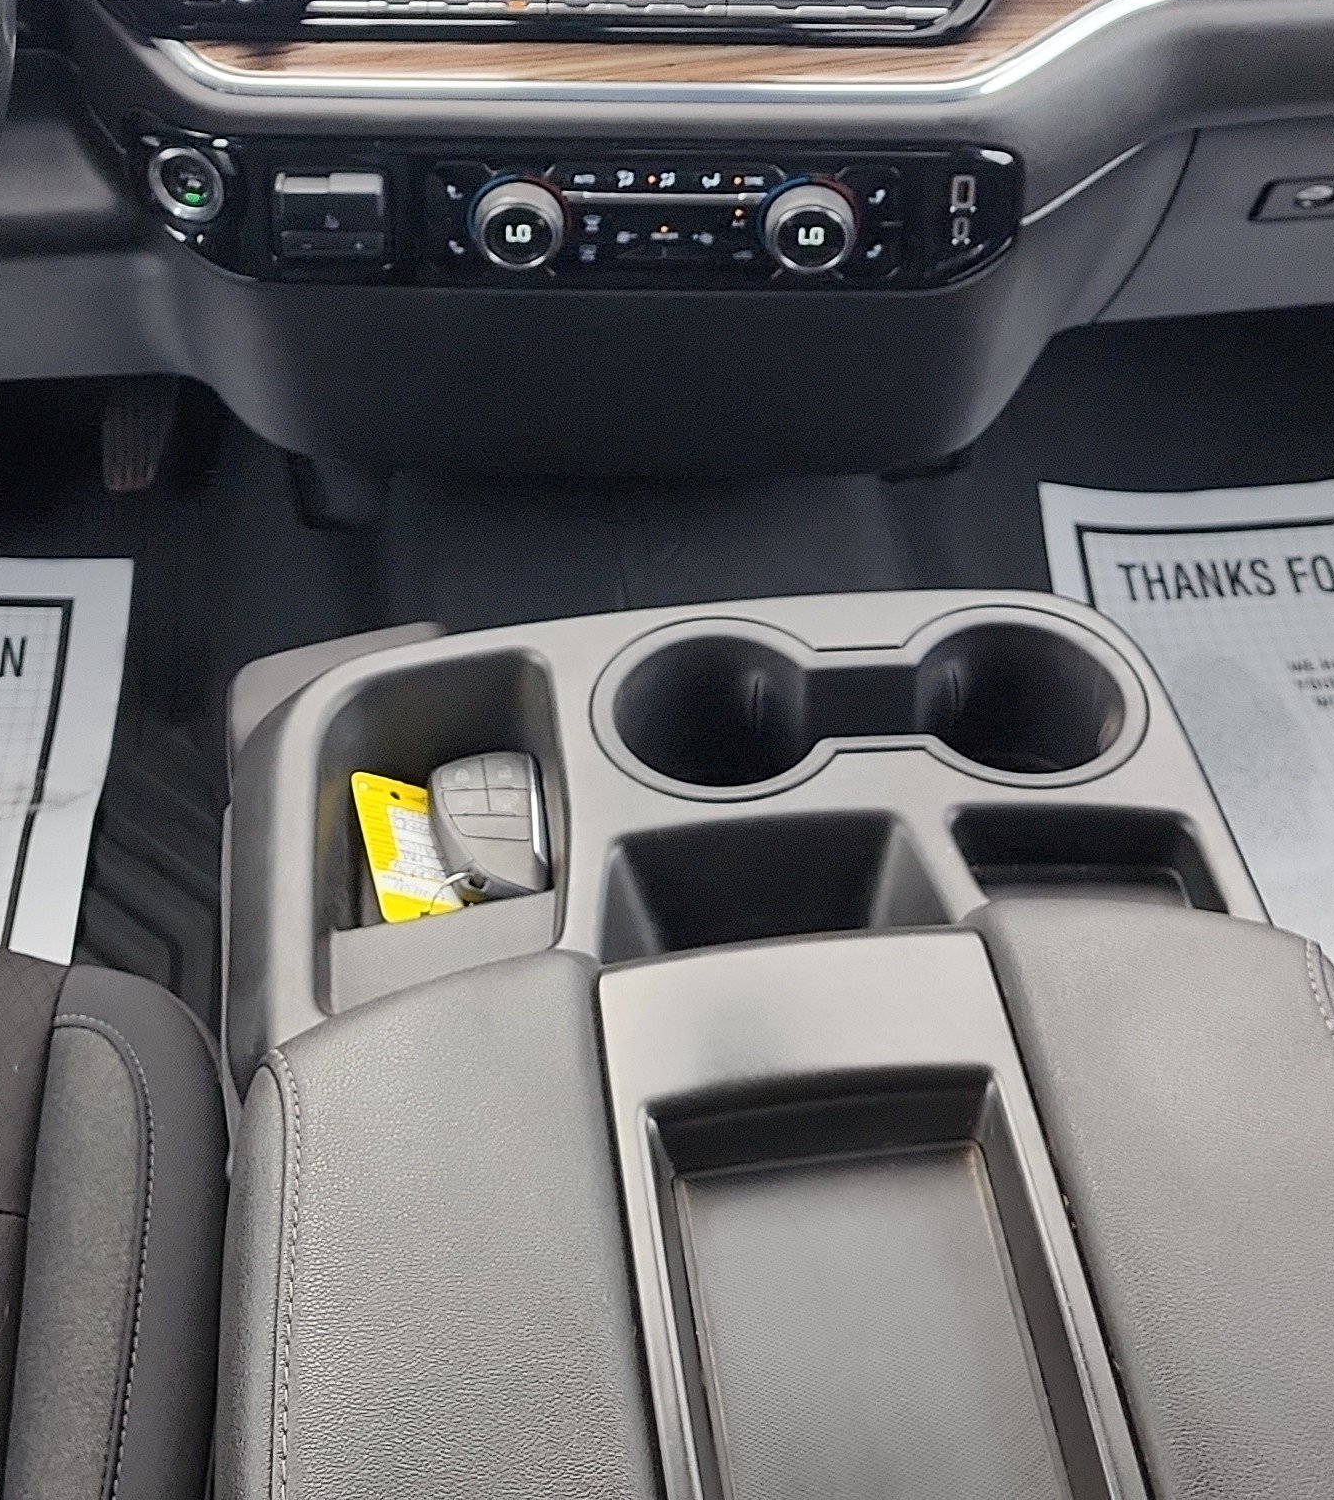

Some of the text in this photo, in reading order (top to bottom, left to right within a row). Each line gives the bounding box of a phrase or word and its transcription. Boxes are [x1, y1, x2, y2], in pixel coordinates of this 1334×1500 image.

[505, 224, 532, 243] LO
[797, 227, 825, 246] LO
[1117, 558, 1276, 602] THANKS
